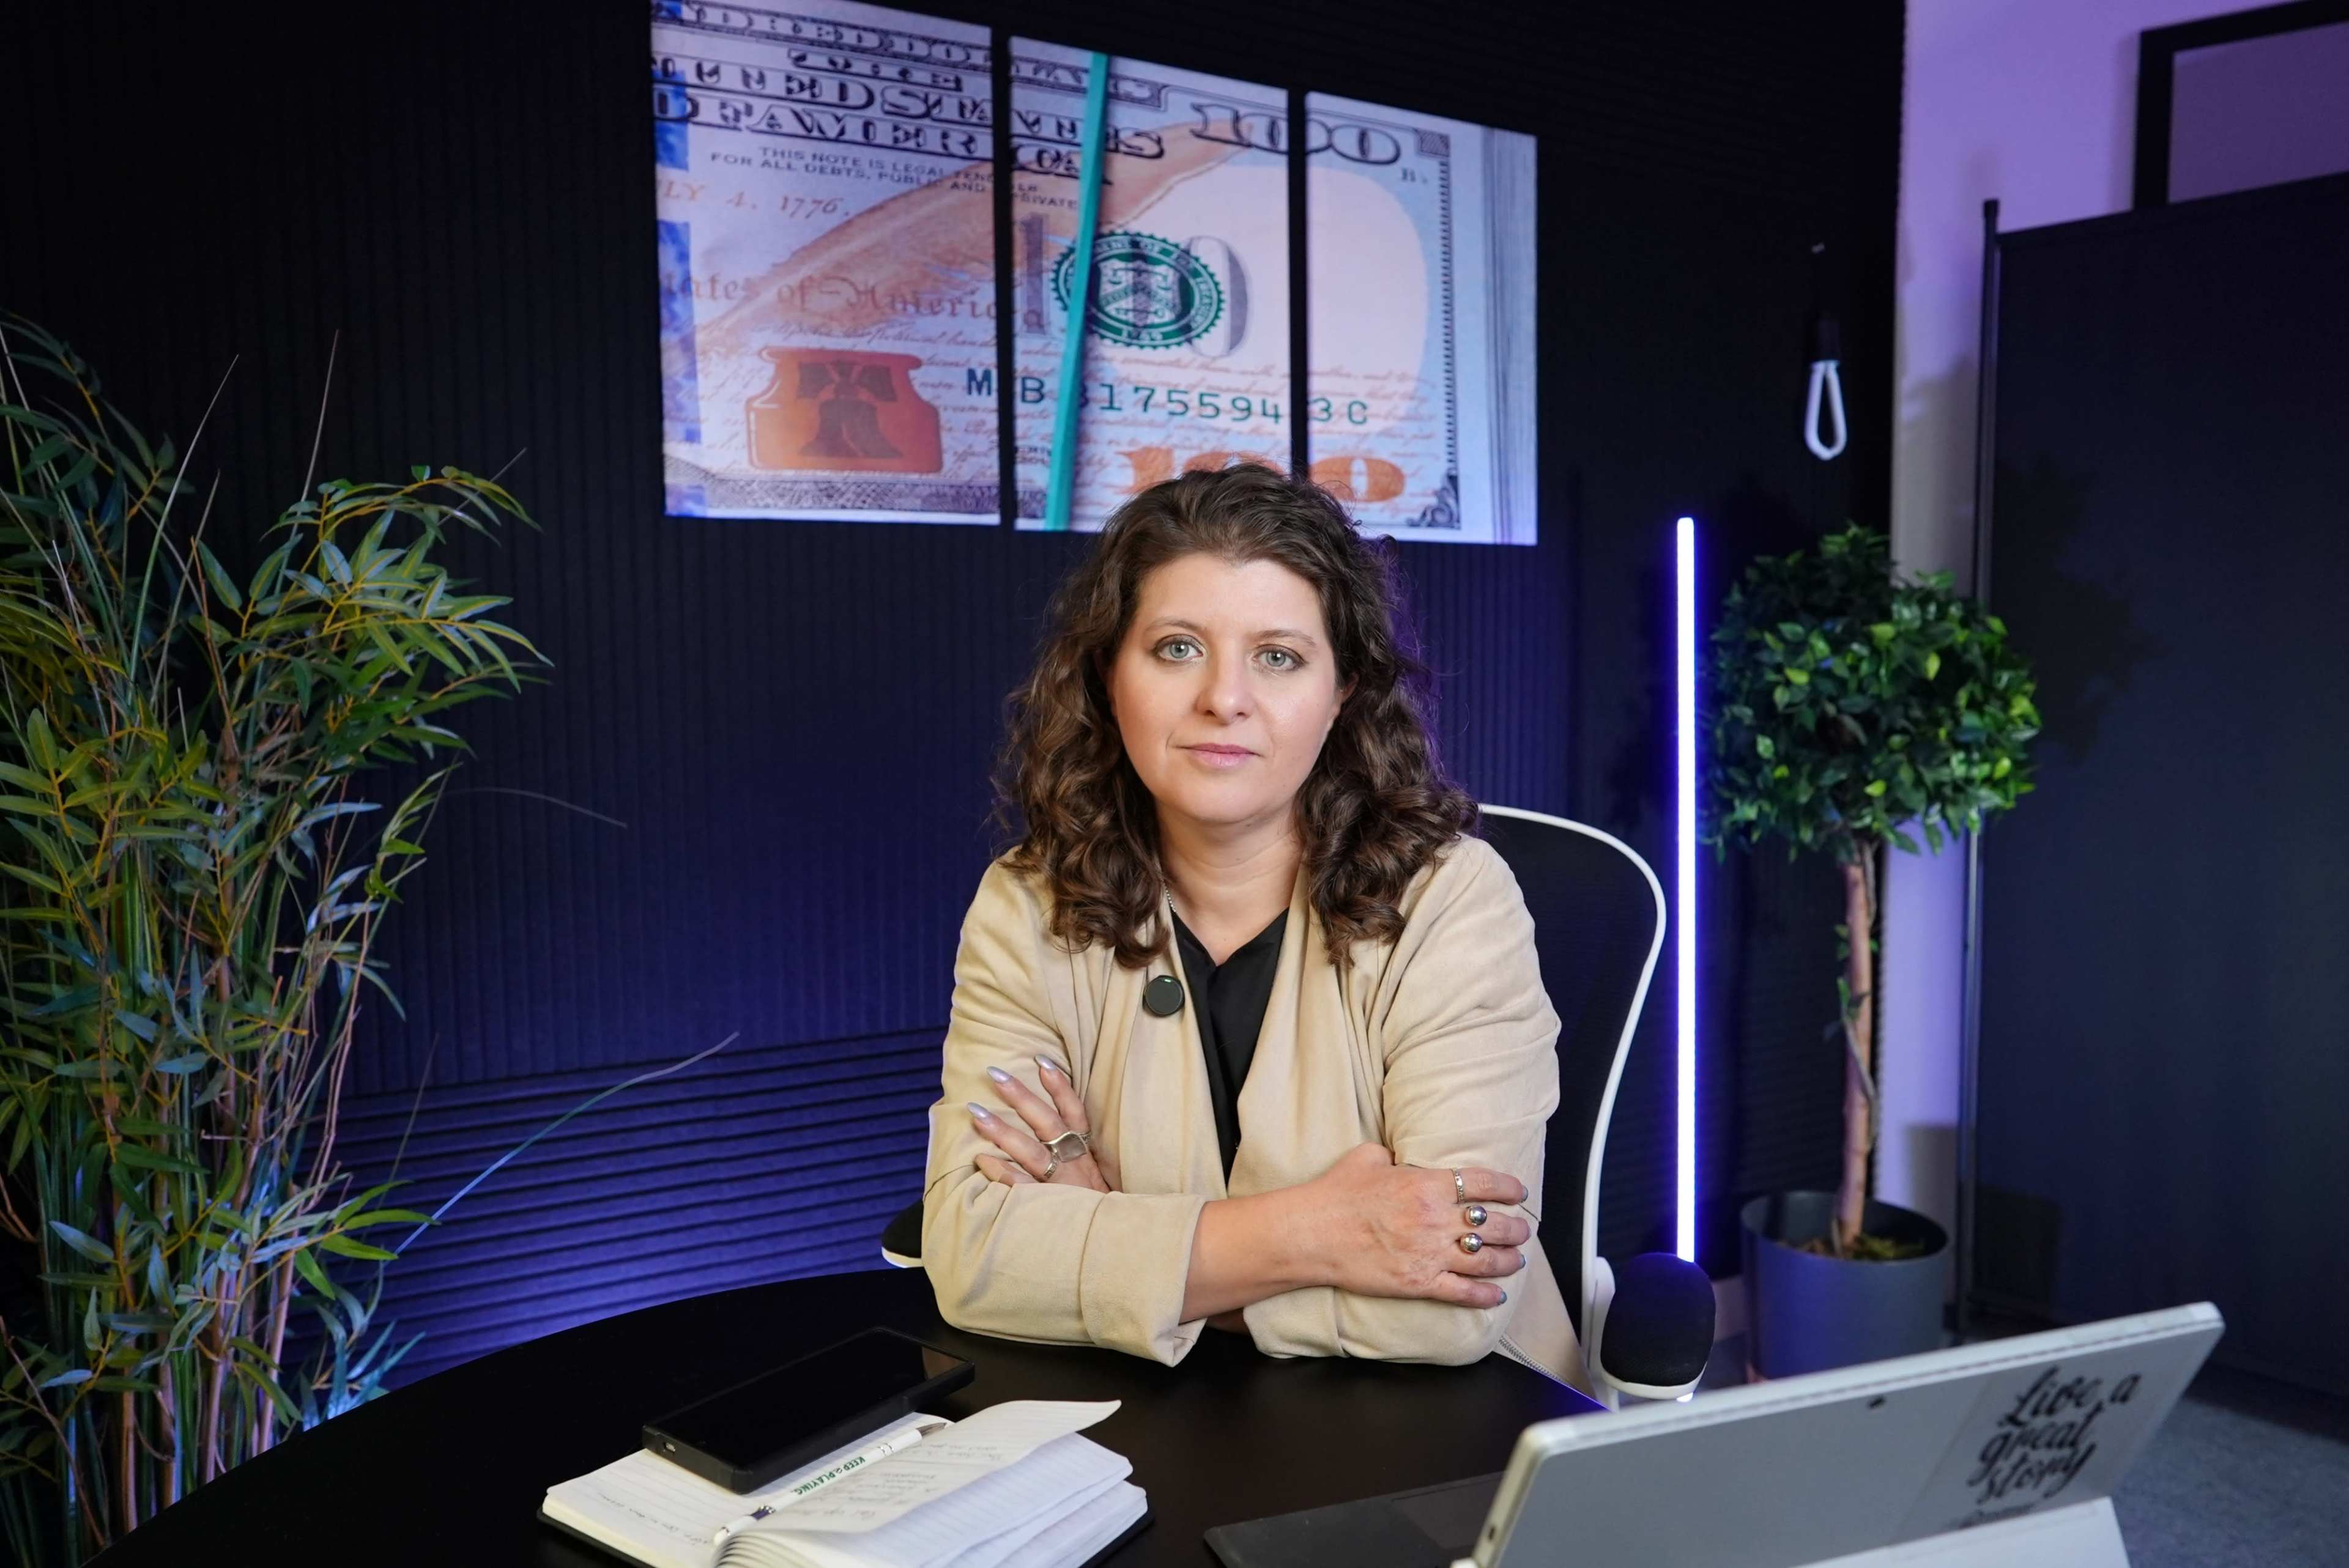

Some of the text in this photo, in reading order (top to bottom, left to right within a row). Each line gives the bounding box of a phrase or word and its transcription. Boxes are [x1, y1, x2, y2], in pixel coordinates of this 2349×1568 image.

[759, 146, 805, 161] THIS
[811, 152, 861, 168] NOTE
[868, 158, 885, 170] IS
[710, 152, 752, 166] FOR
[760, 159, 797, 172] ALL
[949, 182, 986, 193] AND
[843, 1455, 866, 1472] KEEP
